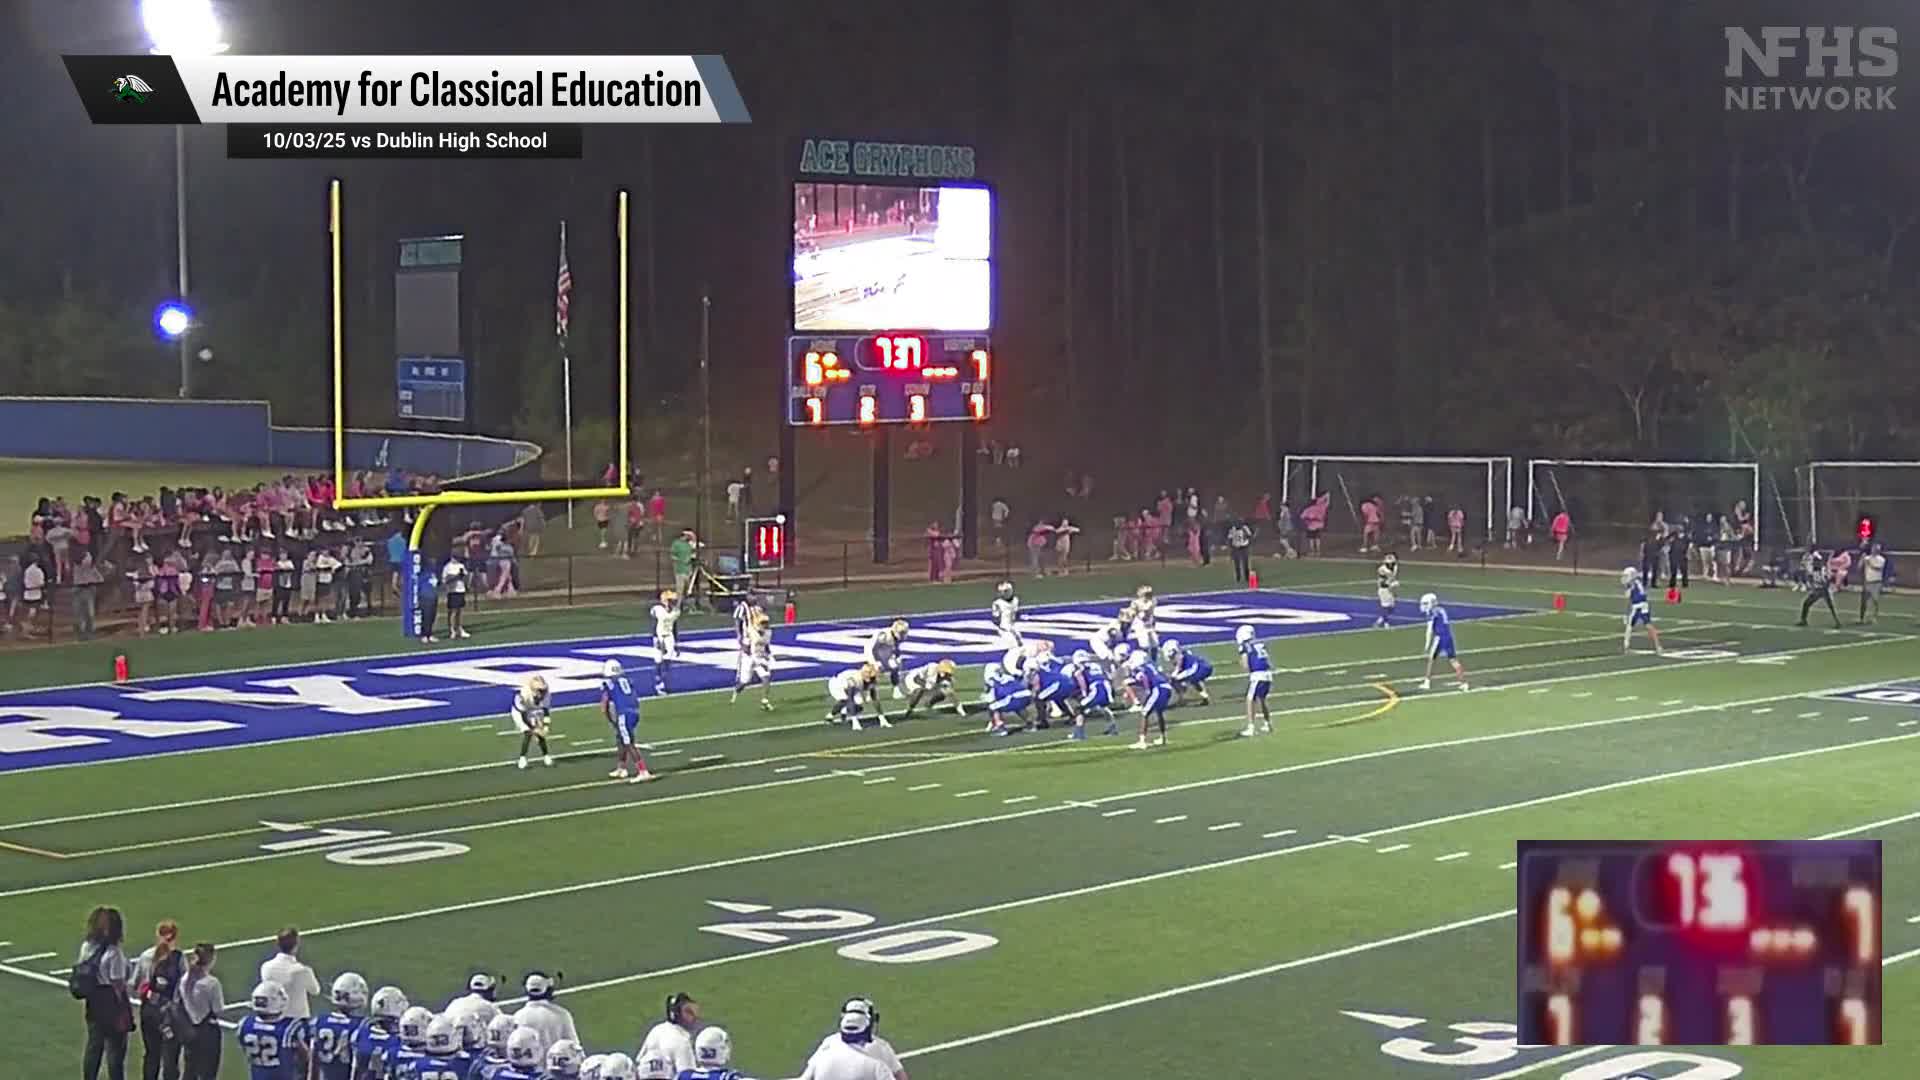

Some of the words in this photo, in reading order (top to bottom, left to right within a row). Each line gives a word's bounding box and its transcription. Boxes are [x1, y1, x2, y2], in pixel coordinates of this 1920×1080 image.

[800, 139, 849, 173] ACE
[853, 142, 975, 177] GRYPHONS
[760, 526, 779, 555] 11
[259, 828, 471, 865] 10
[698, 908, 1000, 963] 20
[244, 1033, 280, 1066] 22
